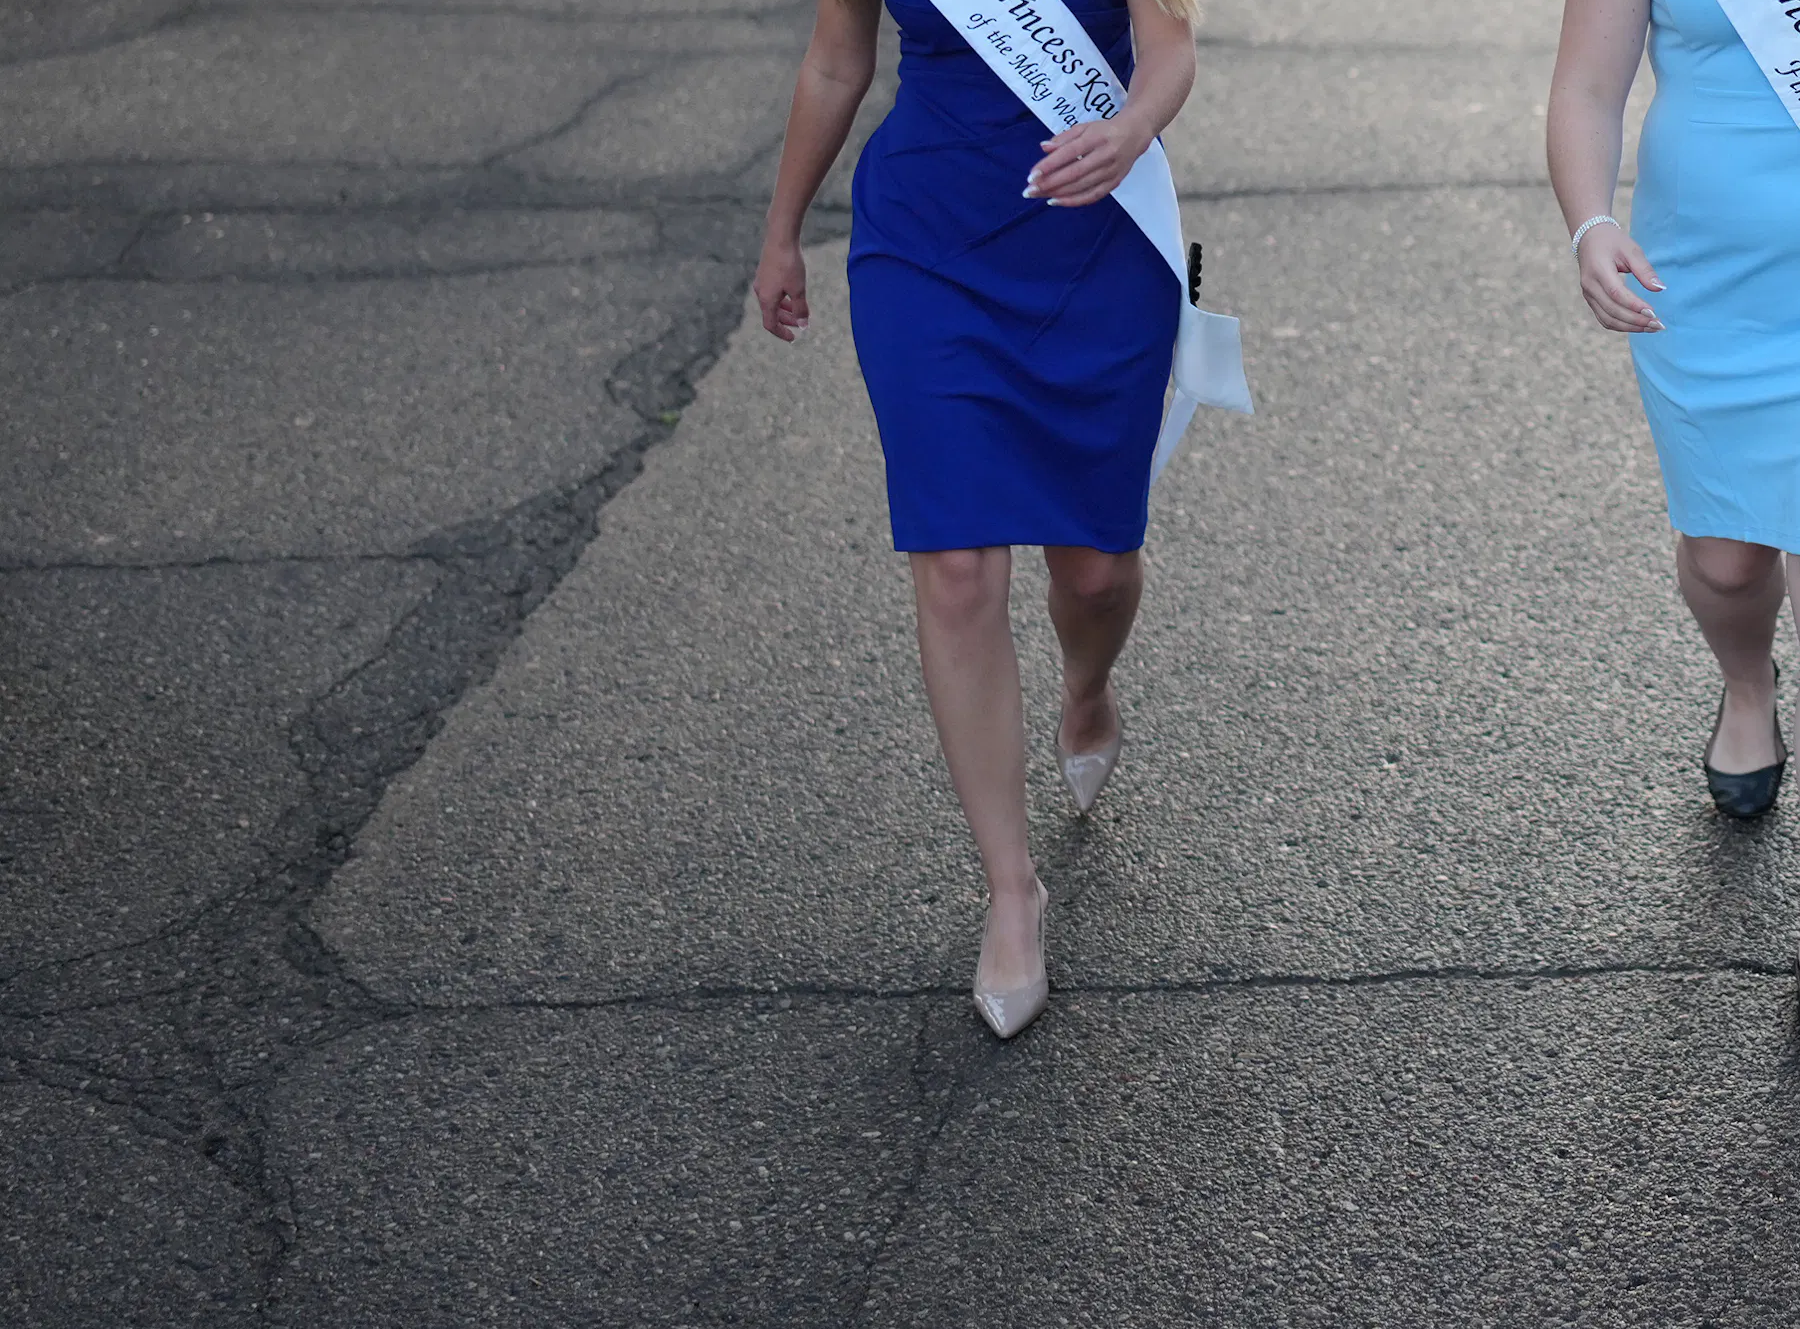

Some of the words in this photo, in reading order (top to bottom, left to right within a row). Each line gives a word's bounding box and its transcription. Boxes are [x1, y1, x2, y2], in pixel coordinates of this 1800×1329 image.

[966, 13, 996, 30] of
[987, 30, 1012, 56] the
[1009, 54, 1052, 102] Milky
[1053, 96, 1078, 128] Wa
